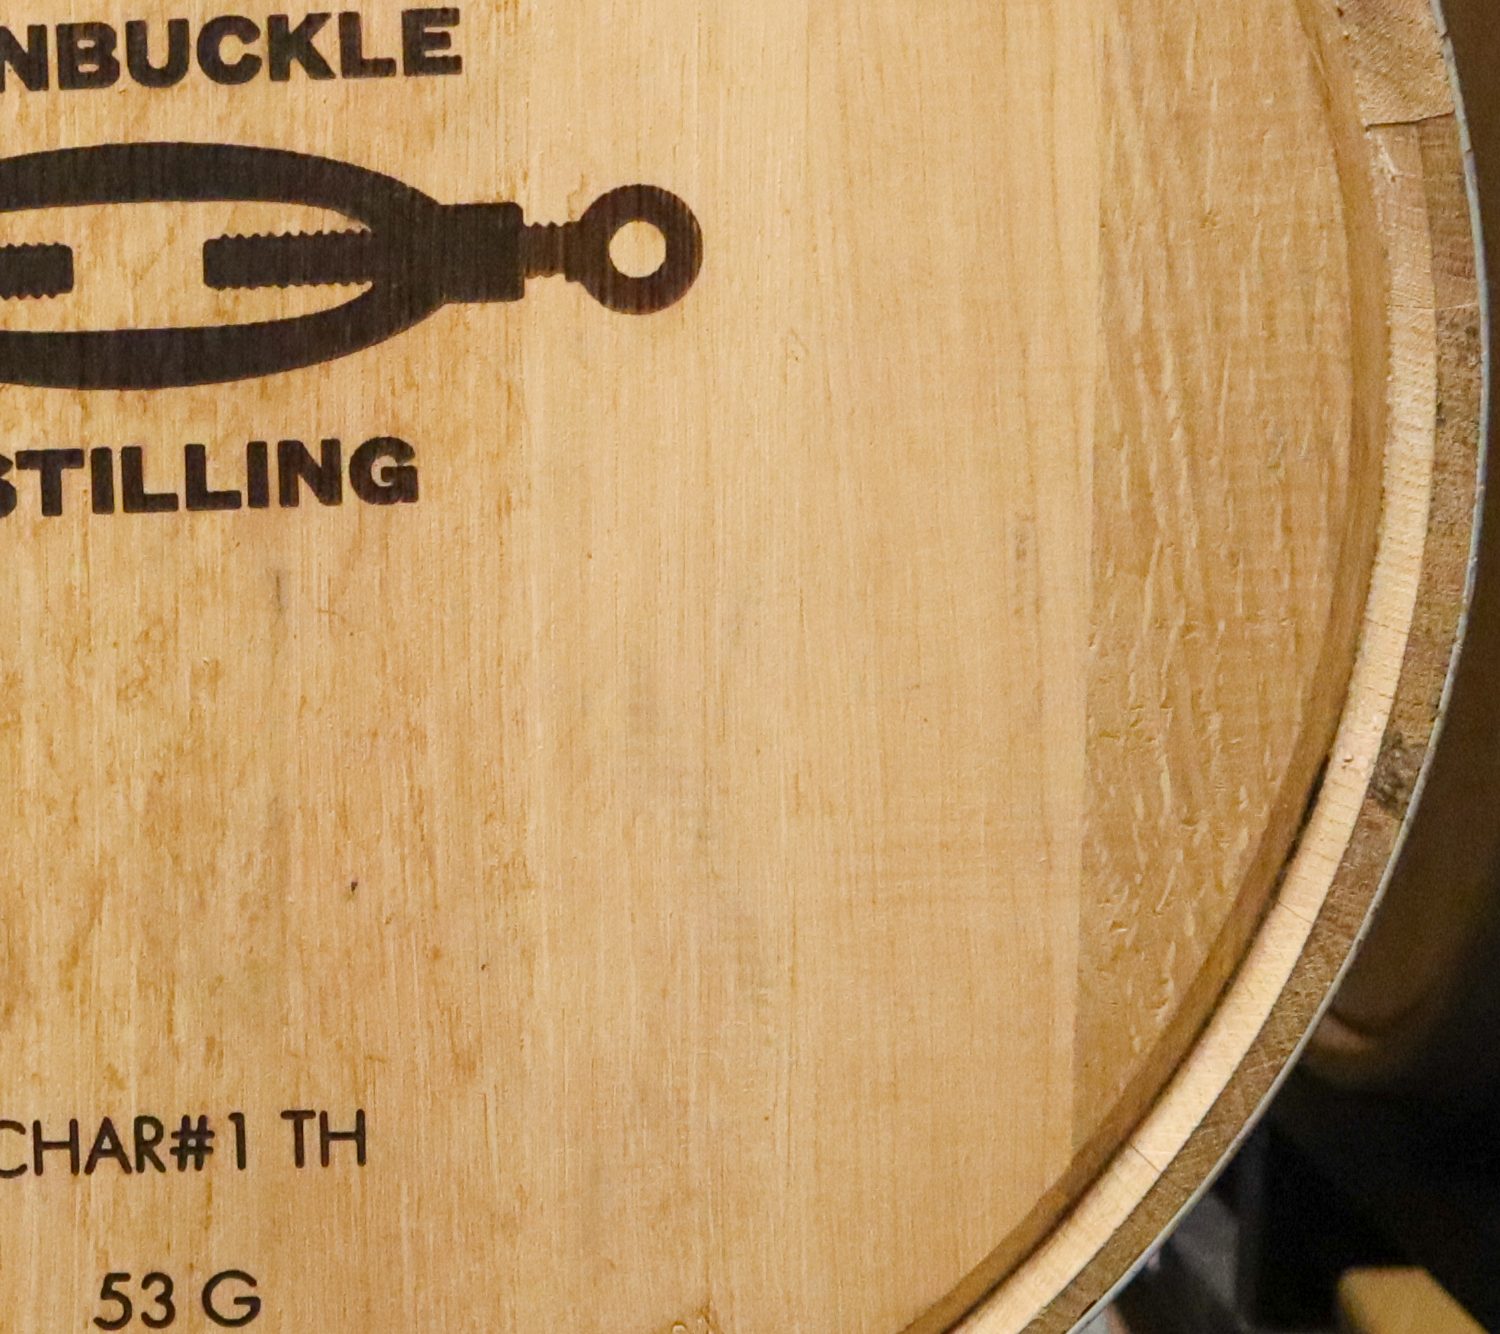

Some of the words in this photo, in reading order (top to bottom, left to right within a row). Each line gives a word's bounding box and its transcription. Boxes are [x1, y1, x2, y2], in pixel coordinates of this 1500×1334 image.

[281, 1108, 369, 1169] TH
[92, 1270, 175, 1331] 53
[201, 1267, 264, 1329] G
